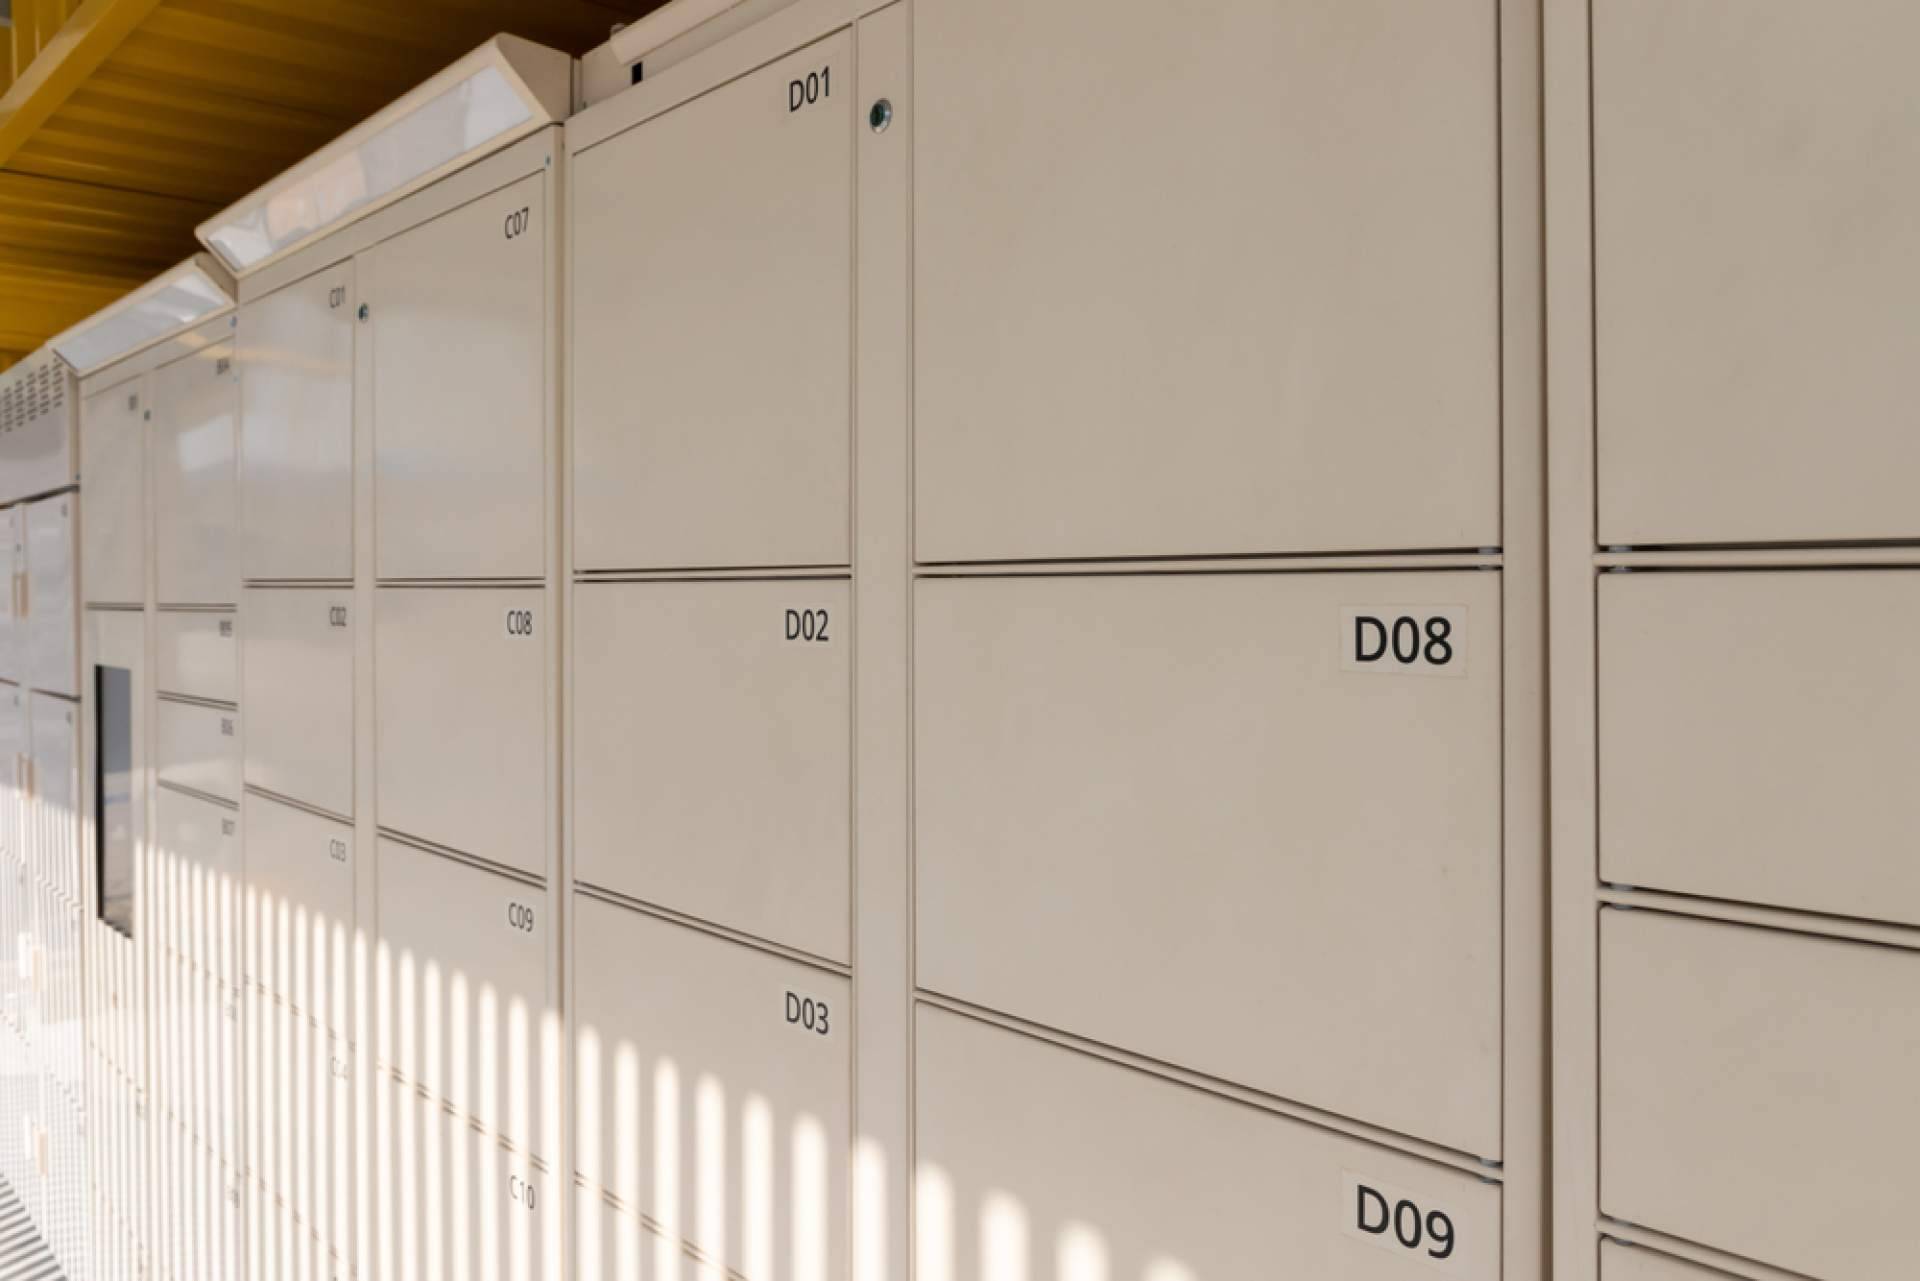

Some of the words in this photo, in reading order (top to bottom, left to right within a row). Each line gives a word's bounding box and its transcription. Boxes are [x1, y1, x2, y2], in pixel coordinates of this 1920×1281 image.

[789, 65, 829, 112] D01
[505, 206, 529, 239] C07
[507, 611, 532, 635] C08
[786, 610, 828, 641] D02
[1355, 616, 1452, 666] D08
[509, 903, 532, 932] C09
[786, 991, 828, 1035] D03
[510, 1175, 535, 1209] C10
[1357, 1184, 1454, 1259] D09
